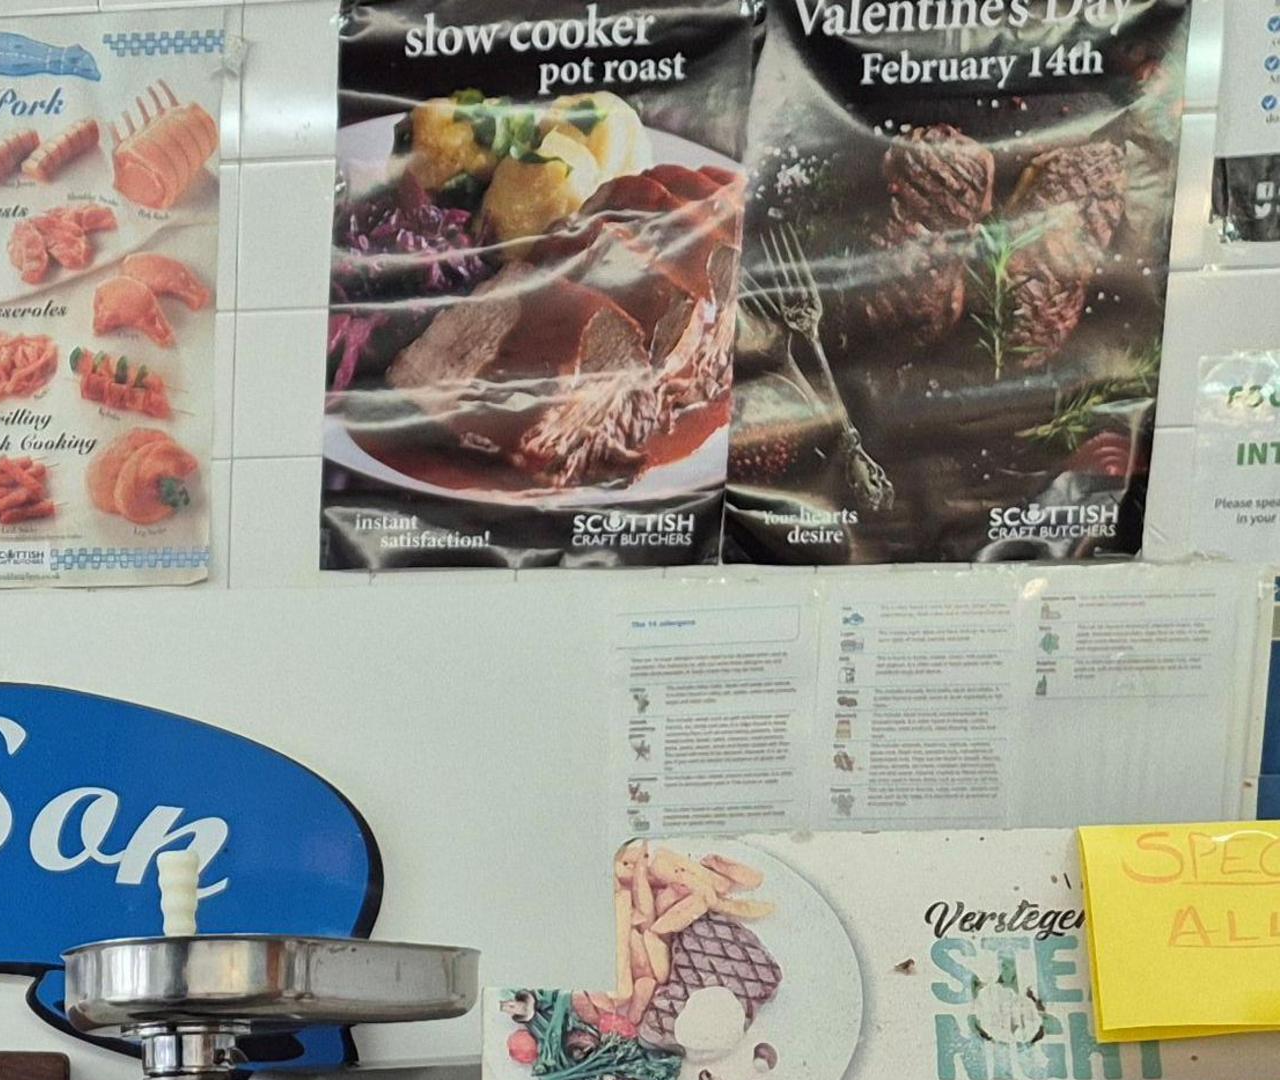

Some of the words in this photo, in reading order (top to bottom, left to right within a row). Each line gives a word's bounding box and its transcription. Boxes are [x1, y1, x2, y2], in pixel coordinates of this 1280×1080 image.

[1040, 0, 1132, 36] Day
[404, 13, 501, 57] slow
[510, 4, 656, 51] cooker
[538, 57, 594, 95] pot
[603, 51, 687, 83] roast
[860, 52, 1018, 88] February
[1029, 41, 1104, 77] 14th
[20, 432, 97, 455] Cooking
[1215, 498, 1253, 509] Please
[355, 514, 418, 531] instant
[573, 511, 694, 533] SCOTTISH
[800, 506, 859, 525] hearts
[989, 504, 1119, 527] SCOTTISH
[1236, 514, 1248, 524] in
[1250, 514, 1277, 526] your
[380, 531, 491, 549] satisfaction!
[572, 533, 617, 546] CRAFT
[620, 532, 693, 546] BUTCHERS
[787, 525, 844, 544] desire
[987, 526, 1037, 540] CRAFT
[1040, 524, 1117, 538] BUTCHERS
